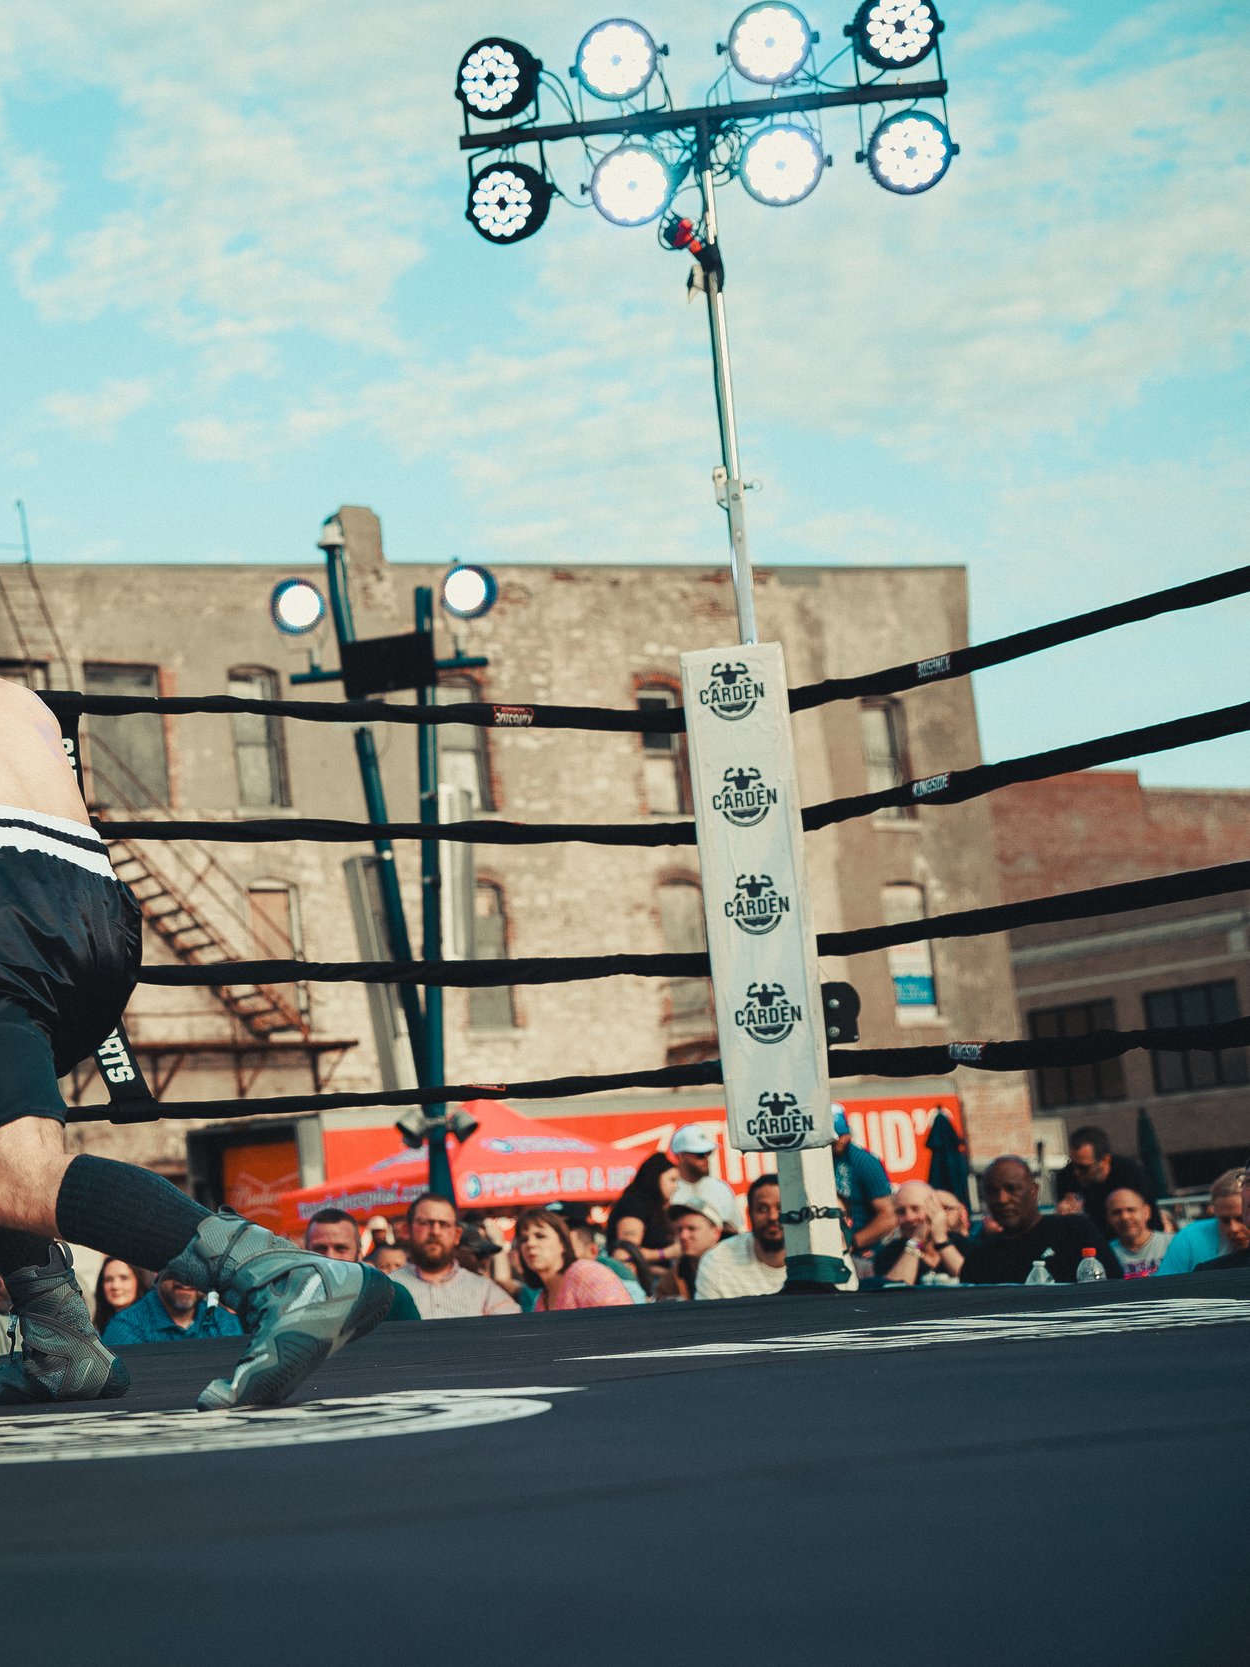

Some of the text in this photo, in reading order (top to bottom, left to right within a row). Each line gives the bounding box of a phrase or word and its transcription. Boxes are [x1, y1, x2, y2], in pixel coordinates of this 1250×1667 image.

[699, 682, 765, 706] CARDEN
[712, 788, 778, 811] CARDEN
[724, 896, 790, 918] CARDEN
[735, 1005, 802, 1027] CARDEN
[747, 1115, 814, 1137] CARDEN
